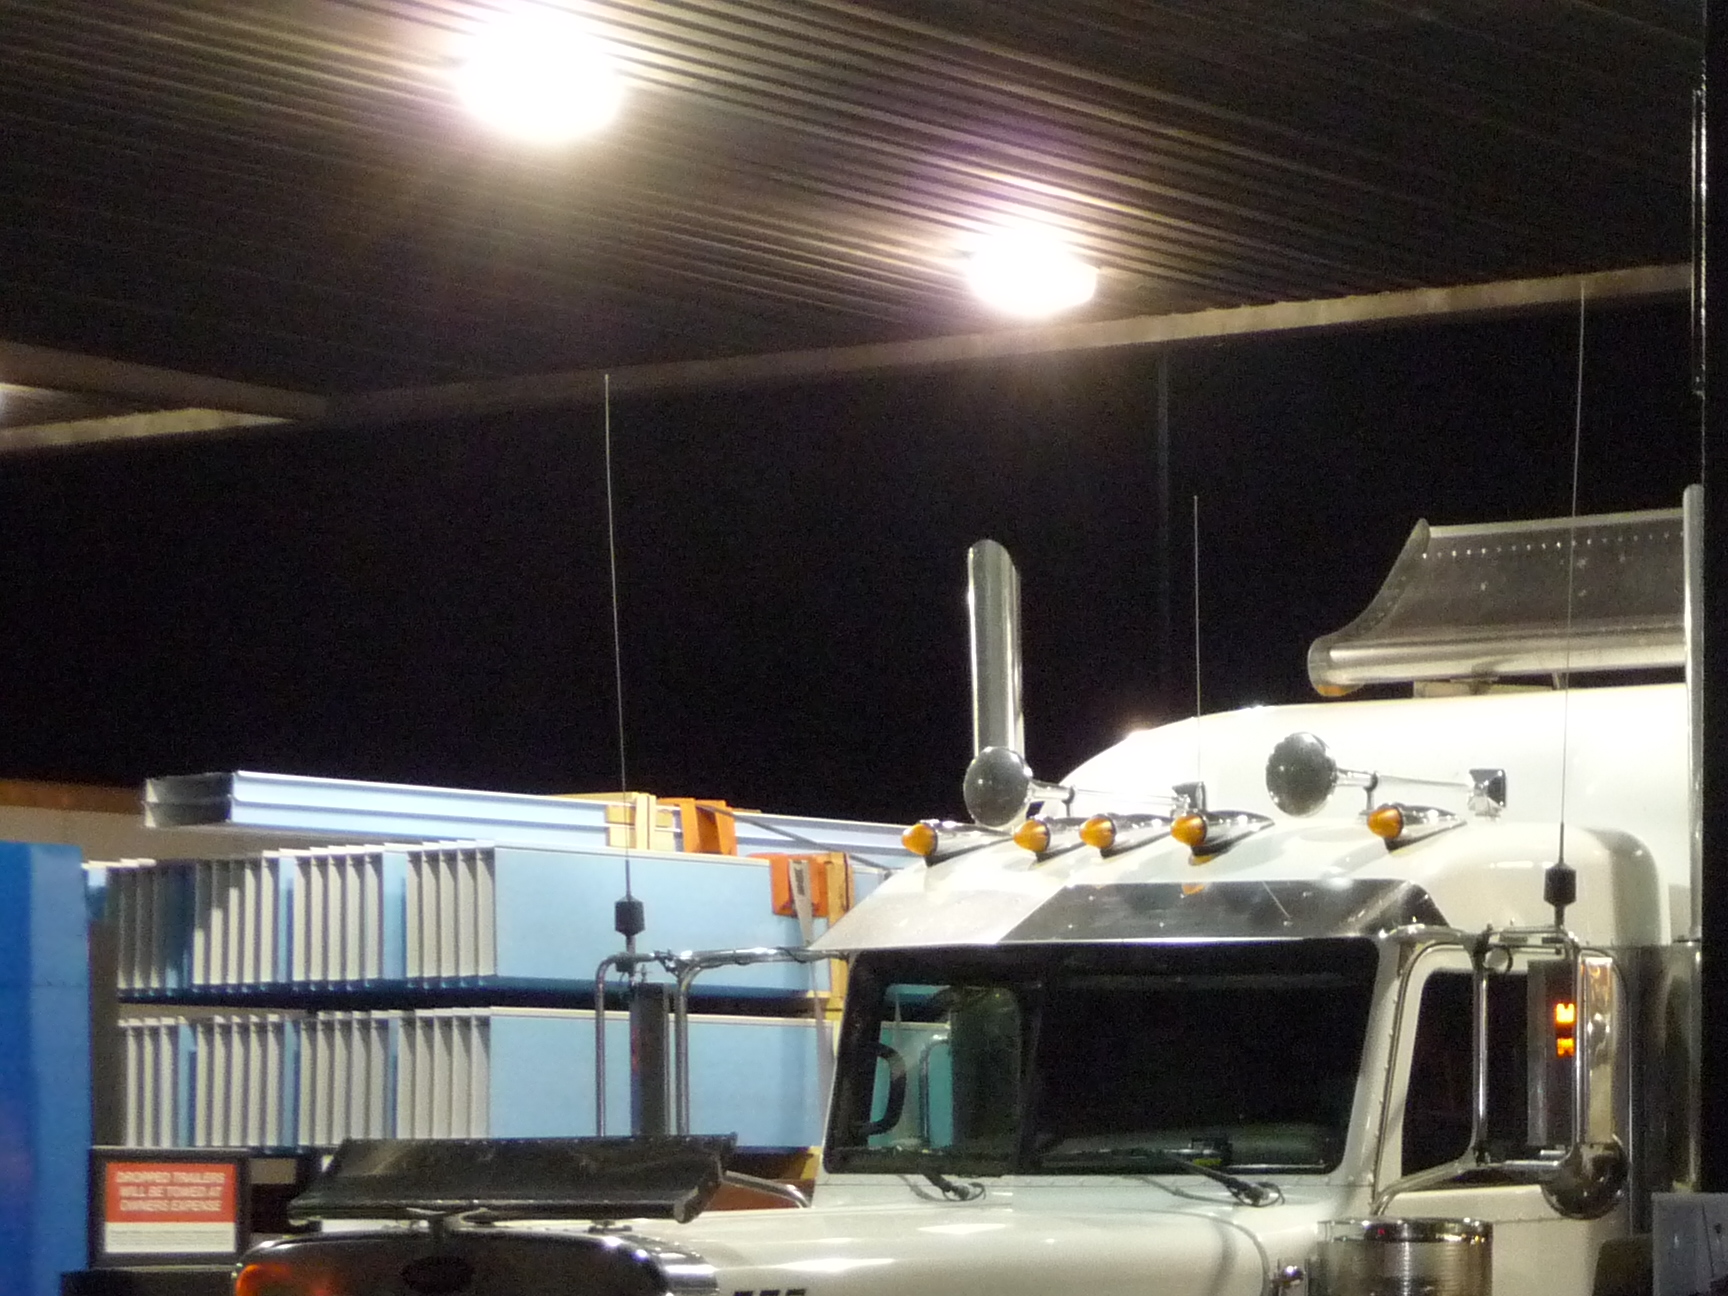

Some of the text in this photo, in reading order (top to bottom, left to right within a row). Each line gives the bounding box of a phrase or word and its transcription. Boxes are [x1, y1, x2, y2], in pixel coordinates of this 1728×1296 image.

[116, 1171, 225, 1184] DROPPED TRAILERS
[120, 1185, 222, 1198] WILL BE TOWED AT
[170, 1199, 222, 1212] EXPENSE
